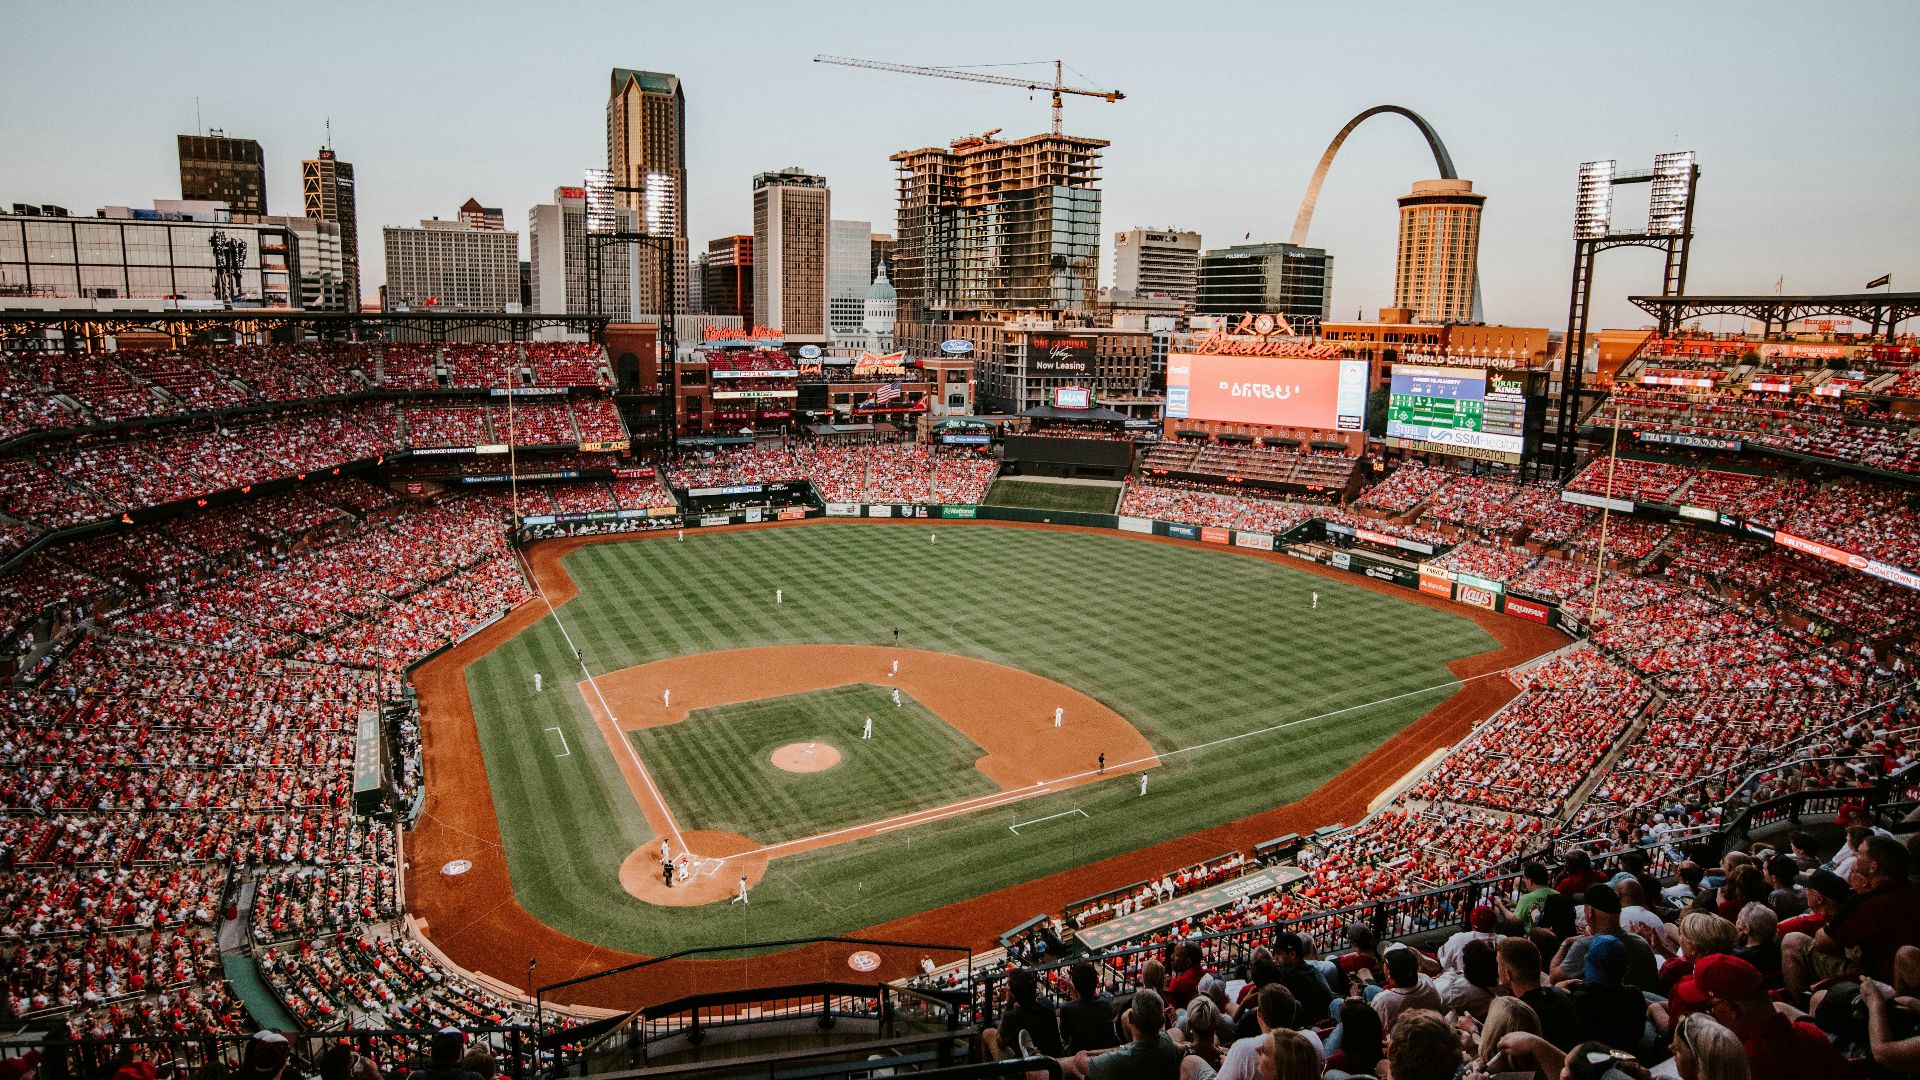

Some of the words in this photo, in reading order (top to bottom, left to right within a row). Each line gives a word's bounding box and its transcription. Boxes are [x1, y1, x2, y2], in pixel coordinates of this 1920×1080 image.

[703, 323, 746, 340] Cardinals
[746, 323, 784, 340] Nation
[947, 341, 968, 350] Ford
[1034, 340, 1048, 348] ONE
[1052, 340, 1088, 349] CARDINAL
[1192, 331, 1341, 358] Budweiser
[1792, 346, 1839, 354] BUDWEISER
[857, 355, 904, 366] Budweiser
[1036, 361, 1053, 370] Now
[1056, 361, 1085, 371] Leasing
[1407, 353, 1444, 364] WORLD
[1446, 355, 1515, 368] CHAMPIONS
[800, 364, 821, 375] Live!
[879, 366, 905, 374] HOUSE
[1493, 380, 1522, 388] DRAFT
[1645, 433, 1671, 443] THAT'S
[1412, 441, 1421, 450] ST.
[1422, 442, 1443, 453] LOUIS
[1447, 444, 1505, 460] POST-DISPATCH
[1783, 536, 1822, 556] HOLLYWOOD
[1869, 566, 1912, 584] HOMETOWN
[1508, 602, 1545, 618] EQUIFAX
[1227, 877, 1274, 897] CHAMPIONS
